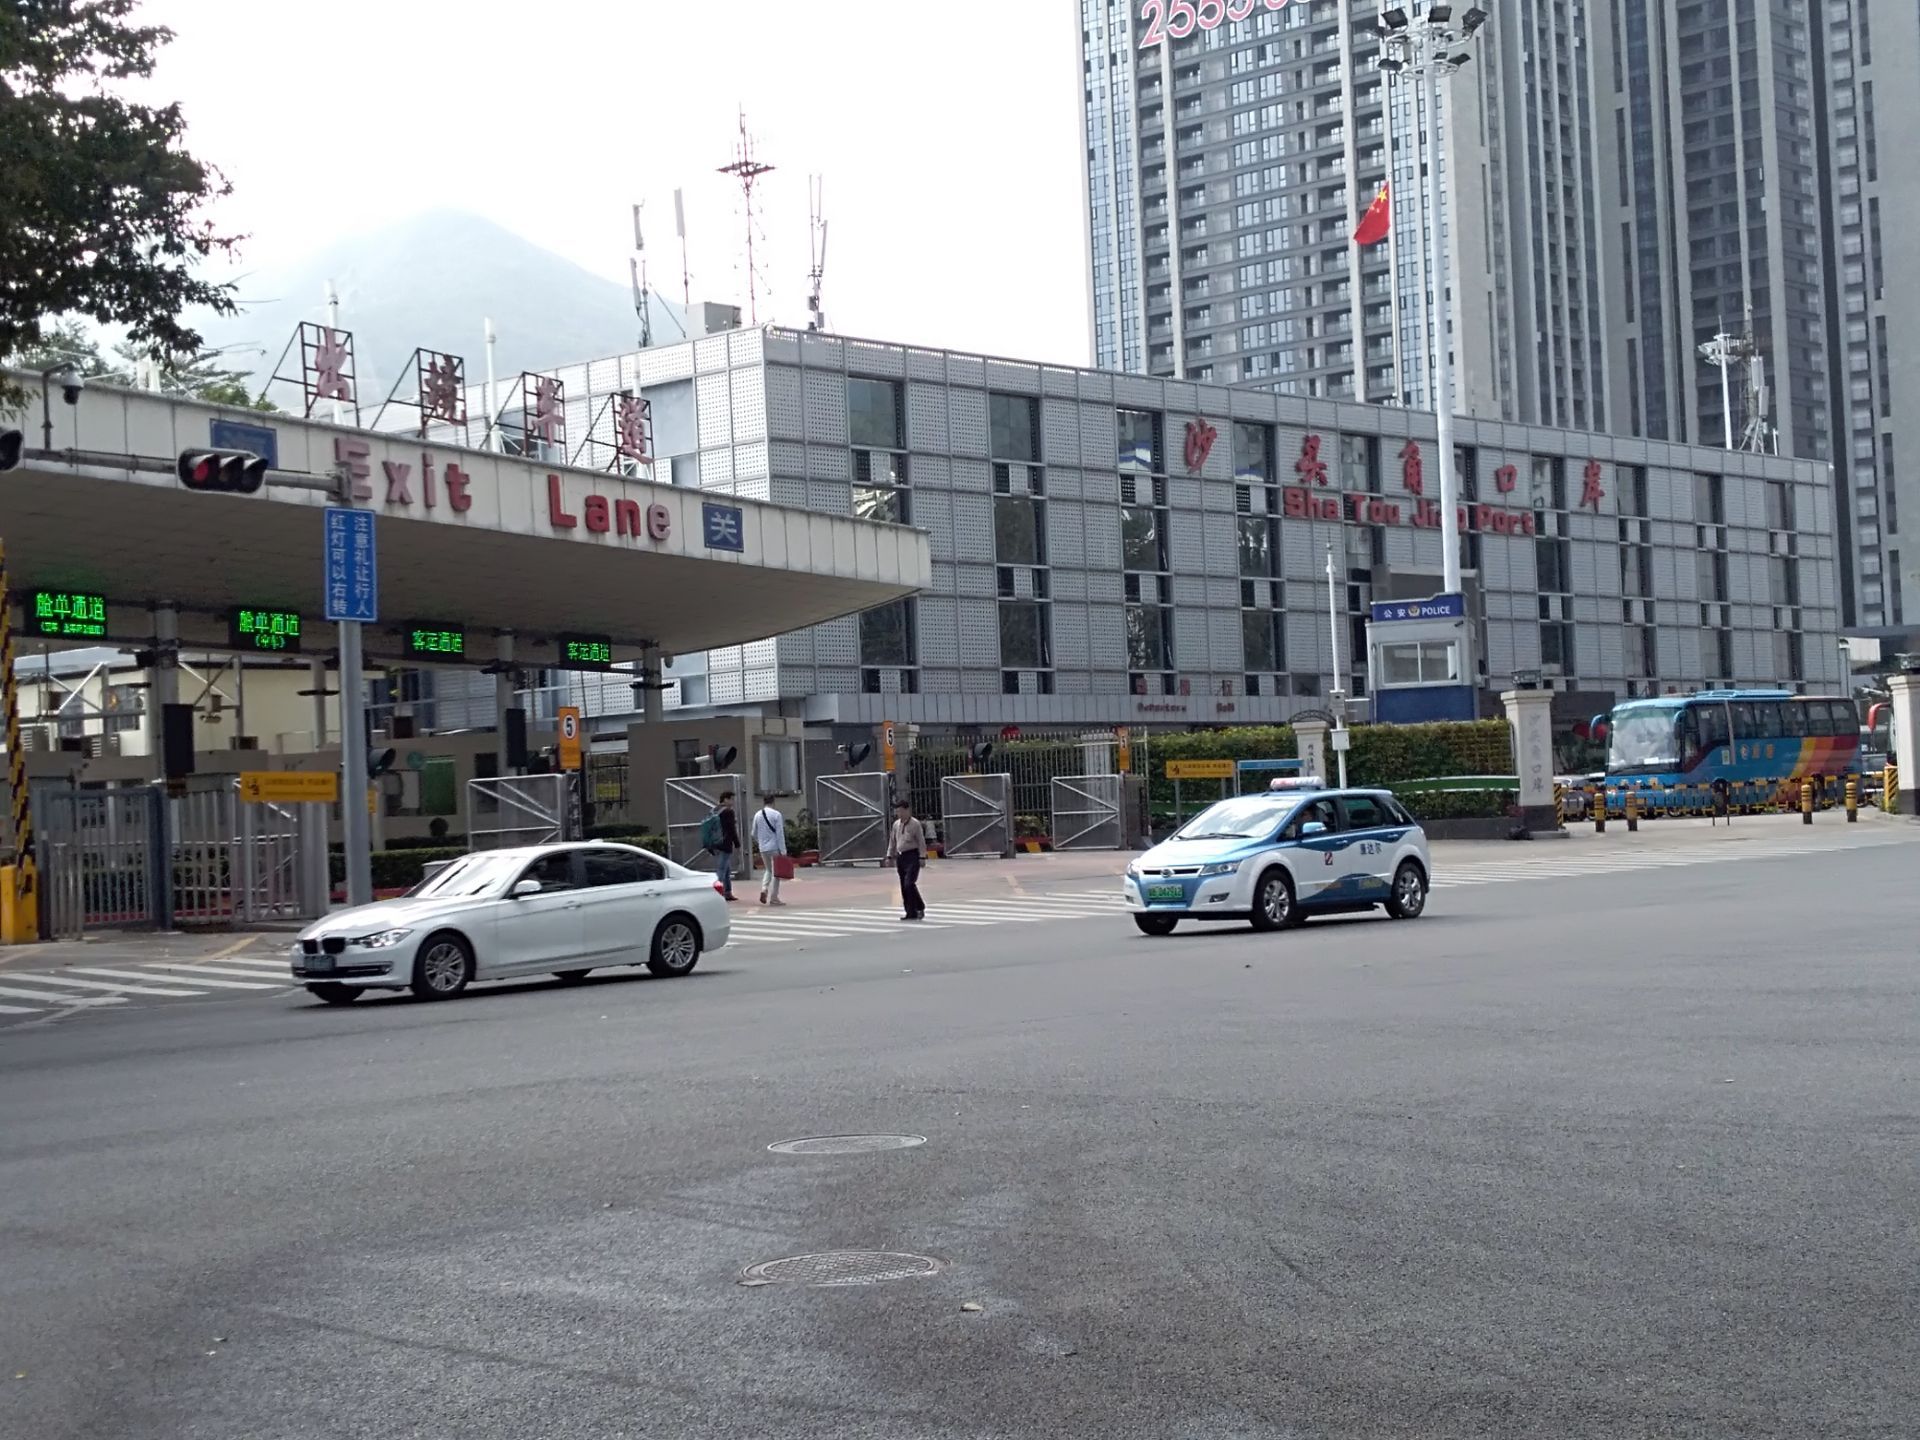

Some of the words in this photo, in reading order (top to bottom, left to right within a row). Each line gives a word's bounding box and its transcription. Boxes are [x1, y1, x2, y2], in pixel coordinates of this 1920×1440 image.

[333, 437, 473, 513] Exit
[547, 473, 671, 540] Lane
[711, 511, 737, 544] 关
[1284, 487, 1341, 519] Sha
[1351, 493, 1401, 525] Tou
[1409, 498, 1468, 531] Jio
[1476, 504, 1536, 537] Port
[354, 516, 370, 615] 注意礼让行人
[1421, 606, 1451, 616] POLICE
[565, 716, 573, 737] 5
